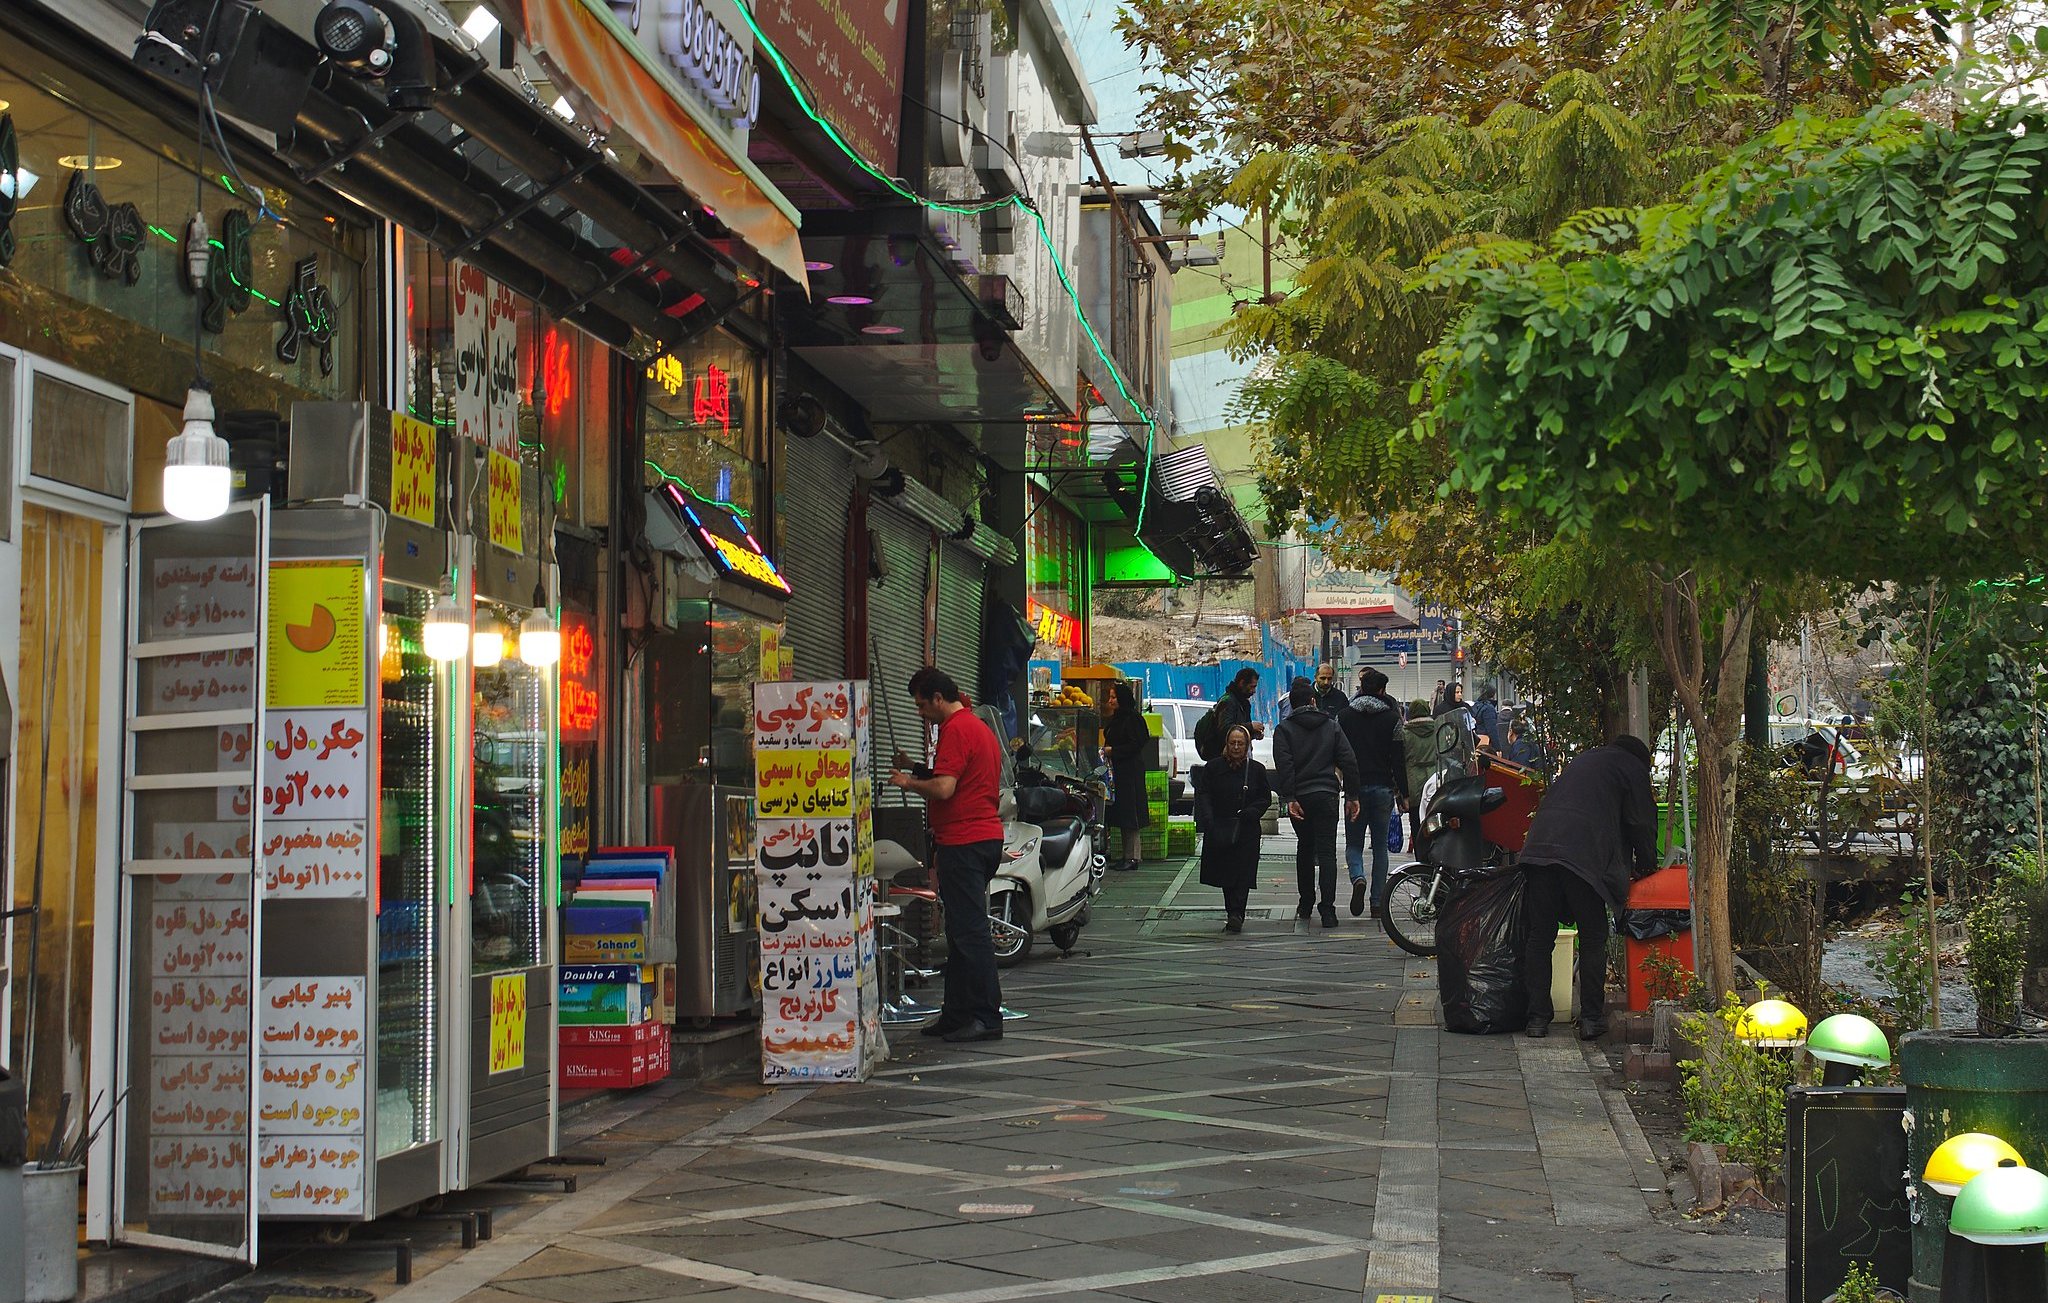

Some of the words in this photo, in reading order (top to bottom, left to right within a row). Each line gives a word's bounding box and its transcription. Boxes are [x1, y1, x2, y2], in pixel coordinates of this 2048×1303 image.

[835, 0, 859, 47] Outdoor
[861, 30, 887, 78] Laminate
[680, 0, 760, 129] 88951790
[155, 564, 218, 588] گوسفندی
[219, 563, 255, 588] راسته
[162, 602, 202, 628] تومان
[161, 679, 205, 703] تومان
[756, 683, 849, 734] فتوکپی
[758, 733, 781, 748] سفید
[784, 738, 790, 749] و
[792, 735, 812, 750] سیاه
[821, 733, 848, 749] رنگی
[759, 760, 794, 788] سیمی
[804, 751, 850, 788] صحافی
[760, 791, 799, 813] درسی
[802, 786, 850, 813] کتابهای
[262, 827, 323, 857] مخصوص
[763, 822, 815, 847] طراحی
[760, 822, 850, 888] تایپ
[761, 887, 850, 933] اسکن
[597, 939, 637, 950] Sahand
[762, 932, 806, 955] اینترنت
[809, 932, 854, 950] خدمات
[564, 971, 604, 981] Double
[607, 970, 616, 980] A
[763, 955, 810, 991] انواع
[812, 955, 854, 989] شارژ
[271, 982, 319, 1009] کبابی
[321, 984, 353, 1010] پنیر
[779, 987, 839, 1022] کارتریج
[158, 1021, 194, 1046] است
[196, 1025, 248, 1051] موجود
[262, 1022, 300, 1043] است
[303, 1025, 359, 1049] موجود
[589, 1030, 611, 1040] KING
[764, 1019, 856, 1054] لمینت
[160, 1061, 213, 1092] کبابی
[212, 1063, 247, 1092] پنیر
[262, 1062, 322, 1089] کوبیده
[325, 1061, 360, 1089] کره
[566, 1064, 588, 1074] KING
[259, 1099, 299, 1122] است
[302, 1103, 361, 1127] موجود
[153, 1141, 218, 1170] زعفرانی
[259, 1143, 317, 1170] زعفرانی
[319, 1148, 361, 1170] جوجه
[155, 1180, 191, 1203] است
[193, 1183, 247, 1209] موجود
[269, 1181, 301, 1200] است
[303, 1184, 350, 1205] موجود
